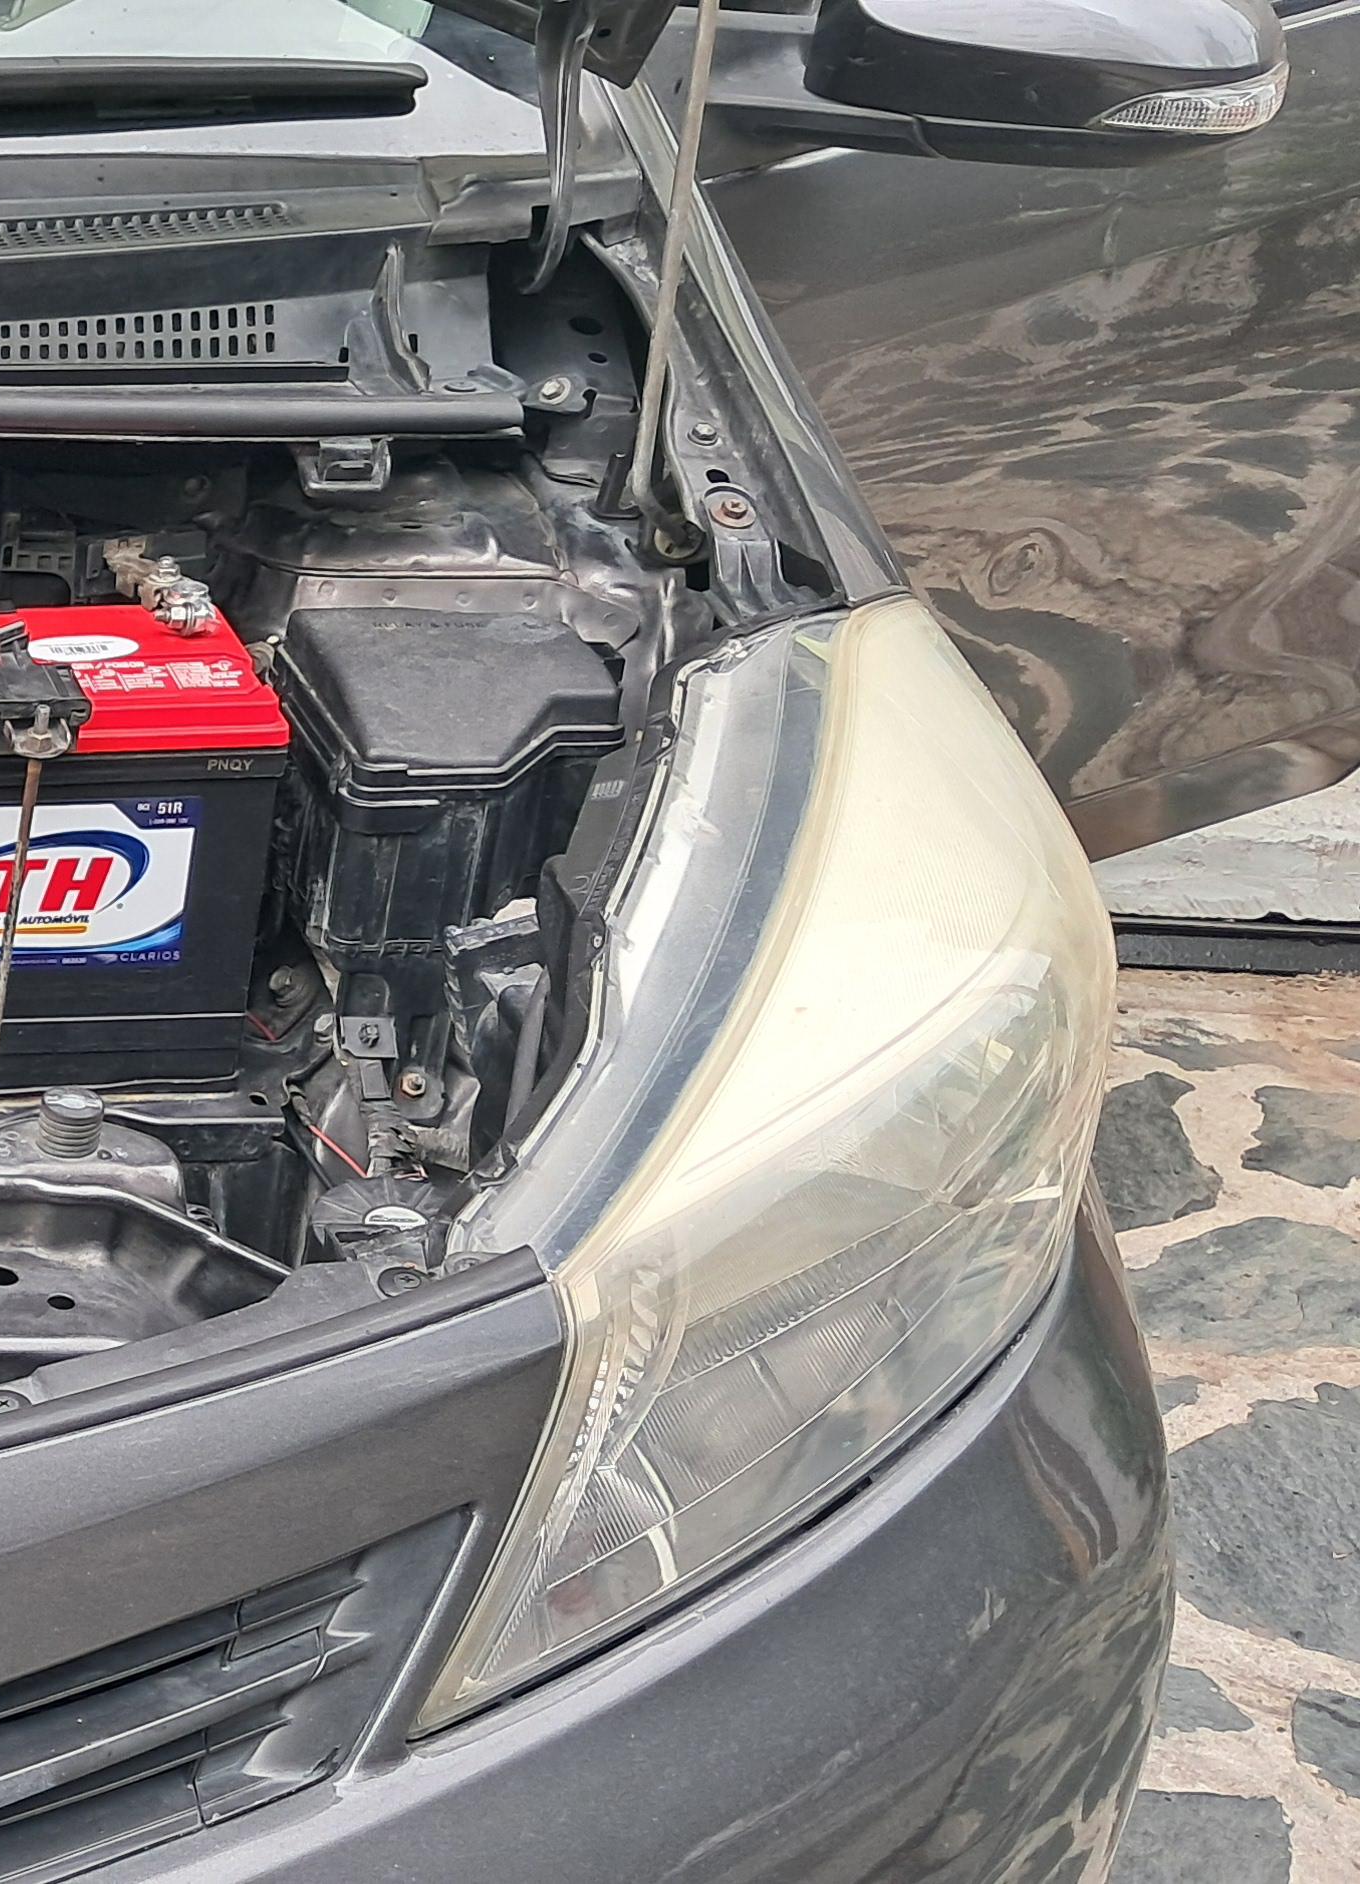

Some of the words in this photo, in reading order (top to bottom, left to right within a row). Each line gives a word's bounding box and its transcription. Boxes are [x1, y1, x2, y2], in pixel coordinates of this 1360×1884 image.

[207, 759, 254, 771] PNQY
[157, 801, 183, 815] 51R
[19, 913, 89, 924] AUTOMÓVIL
[120, 951, 180, 962] CLARIOS
